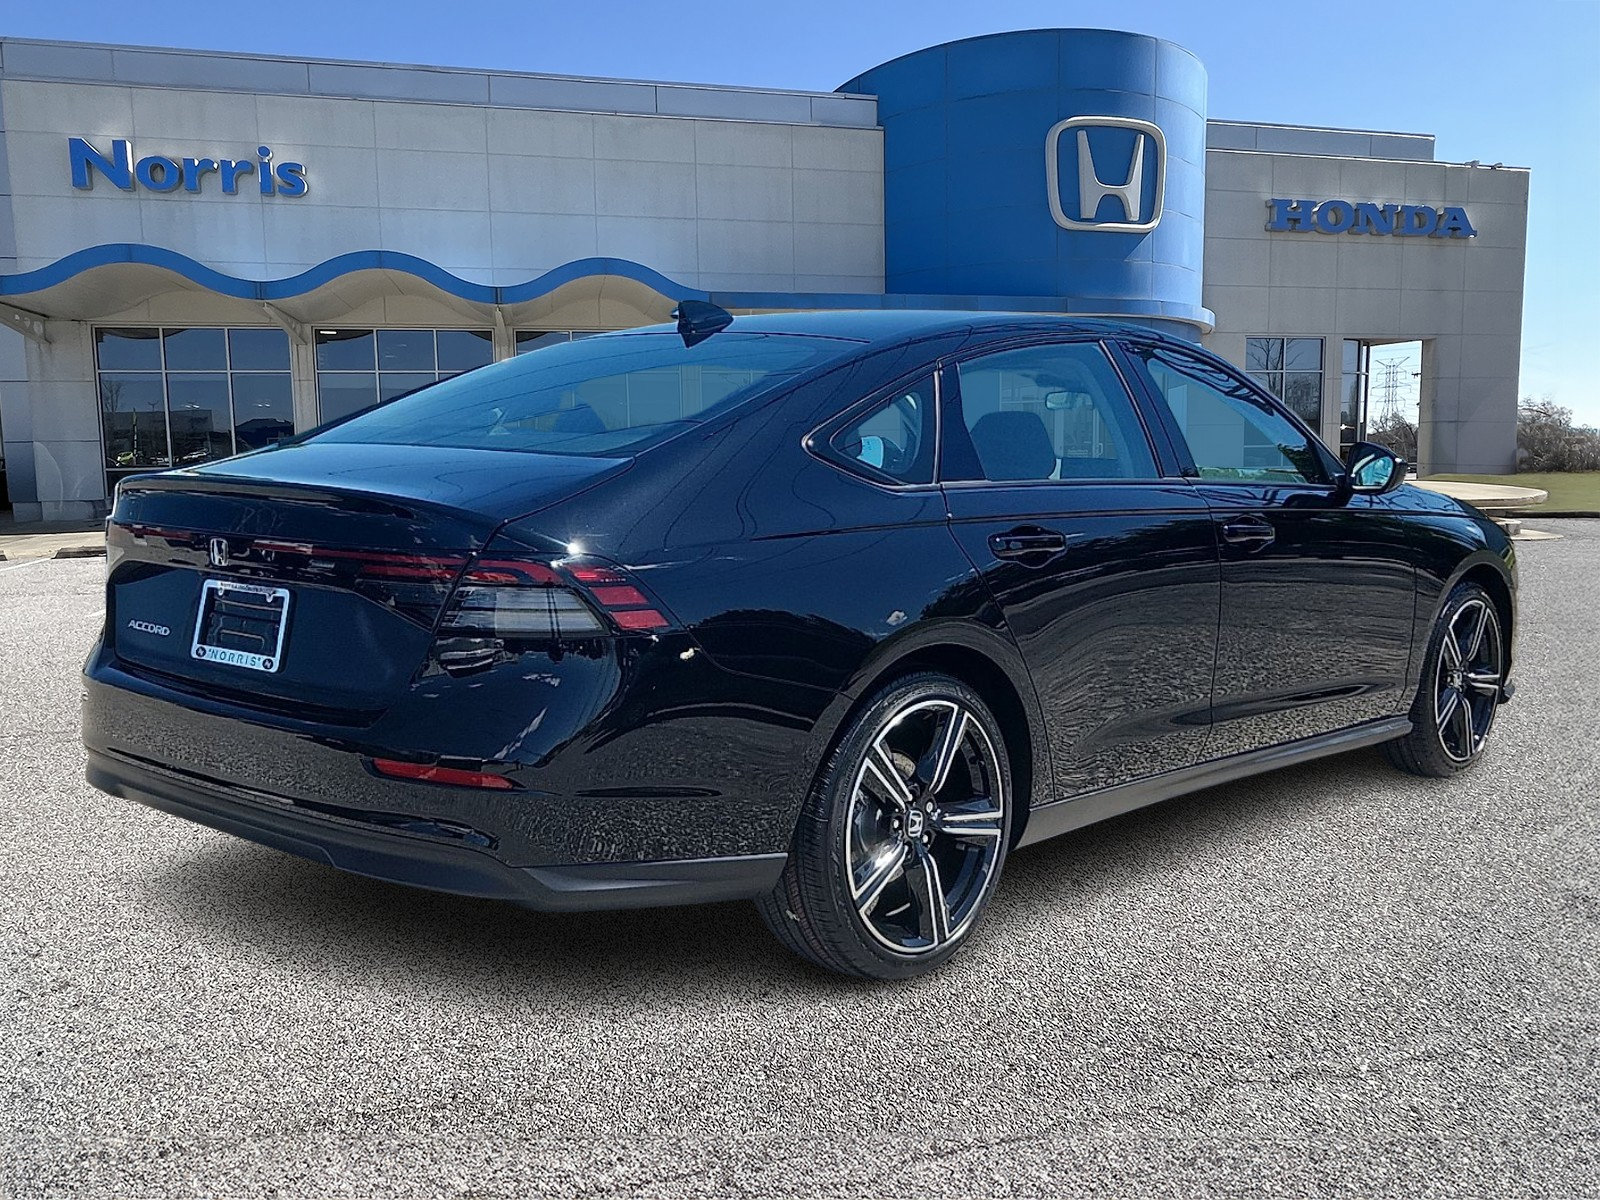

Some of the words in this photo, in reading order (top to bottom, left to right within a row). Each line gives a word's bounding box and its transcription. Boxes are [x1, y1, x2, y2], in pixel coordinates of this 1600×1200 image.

[68, 137, 309, 197] Norris
[1265, 198, 1478, 239] HONDA
[128, 619, 171, 636] ACCORD
